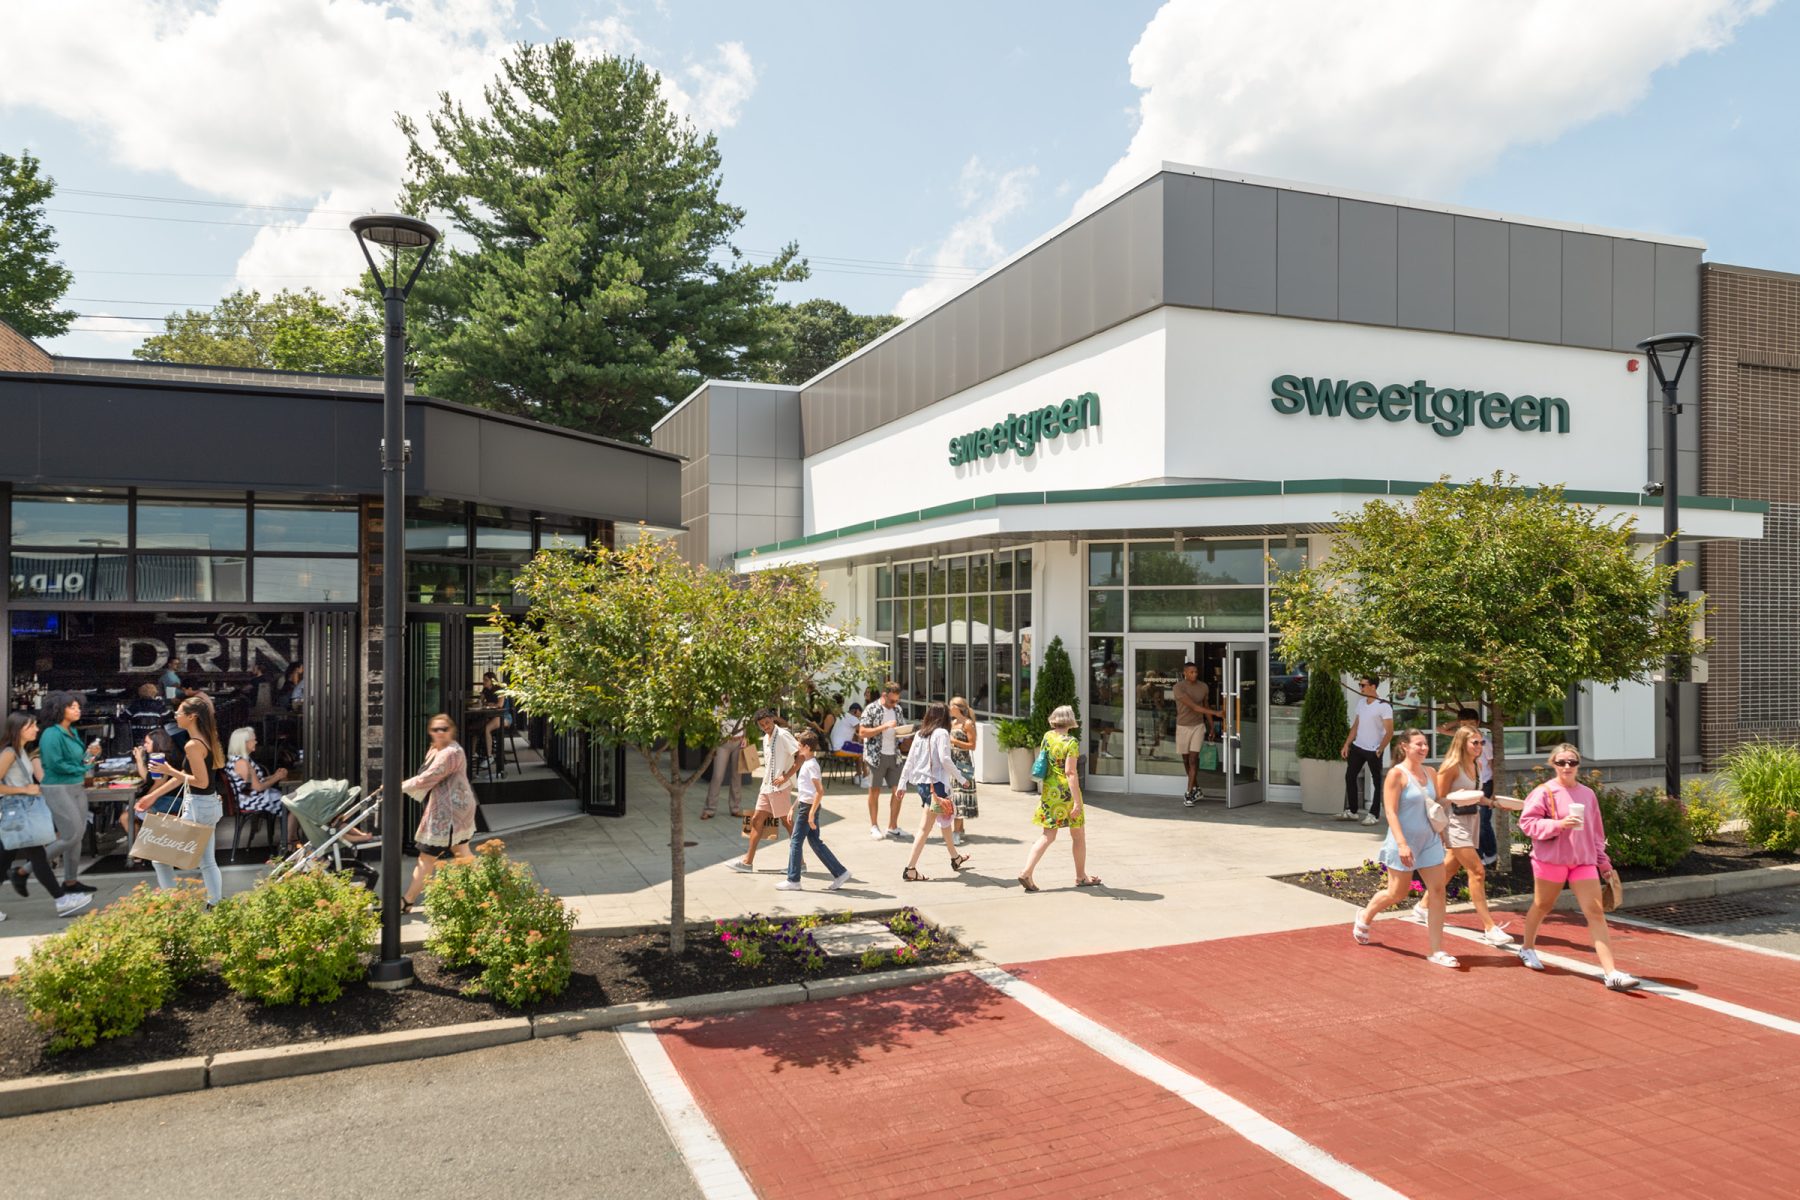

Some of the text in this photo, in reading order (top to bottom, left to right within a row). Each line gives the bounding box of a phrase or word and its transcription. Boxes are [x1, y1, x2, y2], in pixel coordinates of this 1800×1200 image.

[1270, 374, 1570, 438] sweetgreen
[948, 391, 1100, 467] sweetgreen
[216, 619, 272, 637] and
[1186, 615, 1205, 629] 111
[118, 637, 299, 673] DRIN
[137, 827, 198, 854] Madewell
